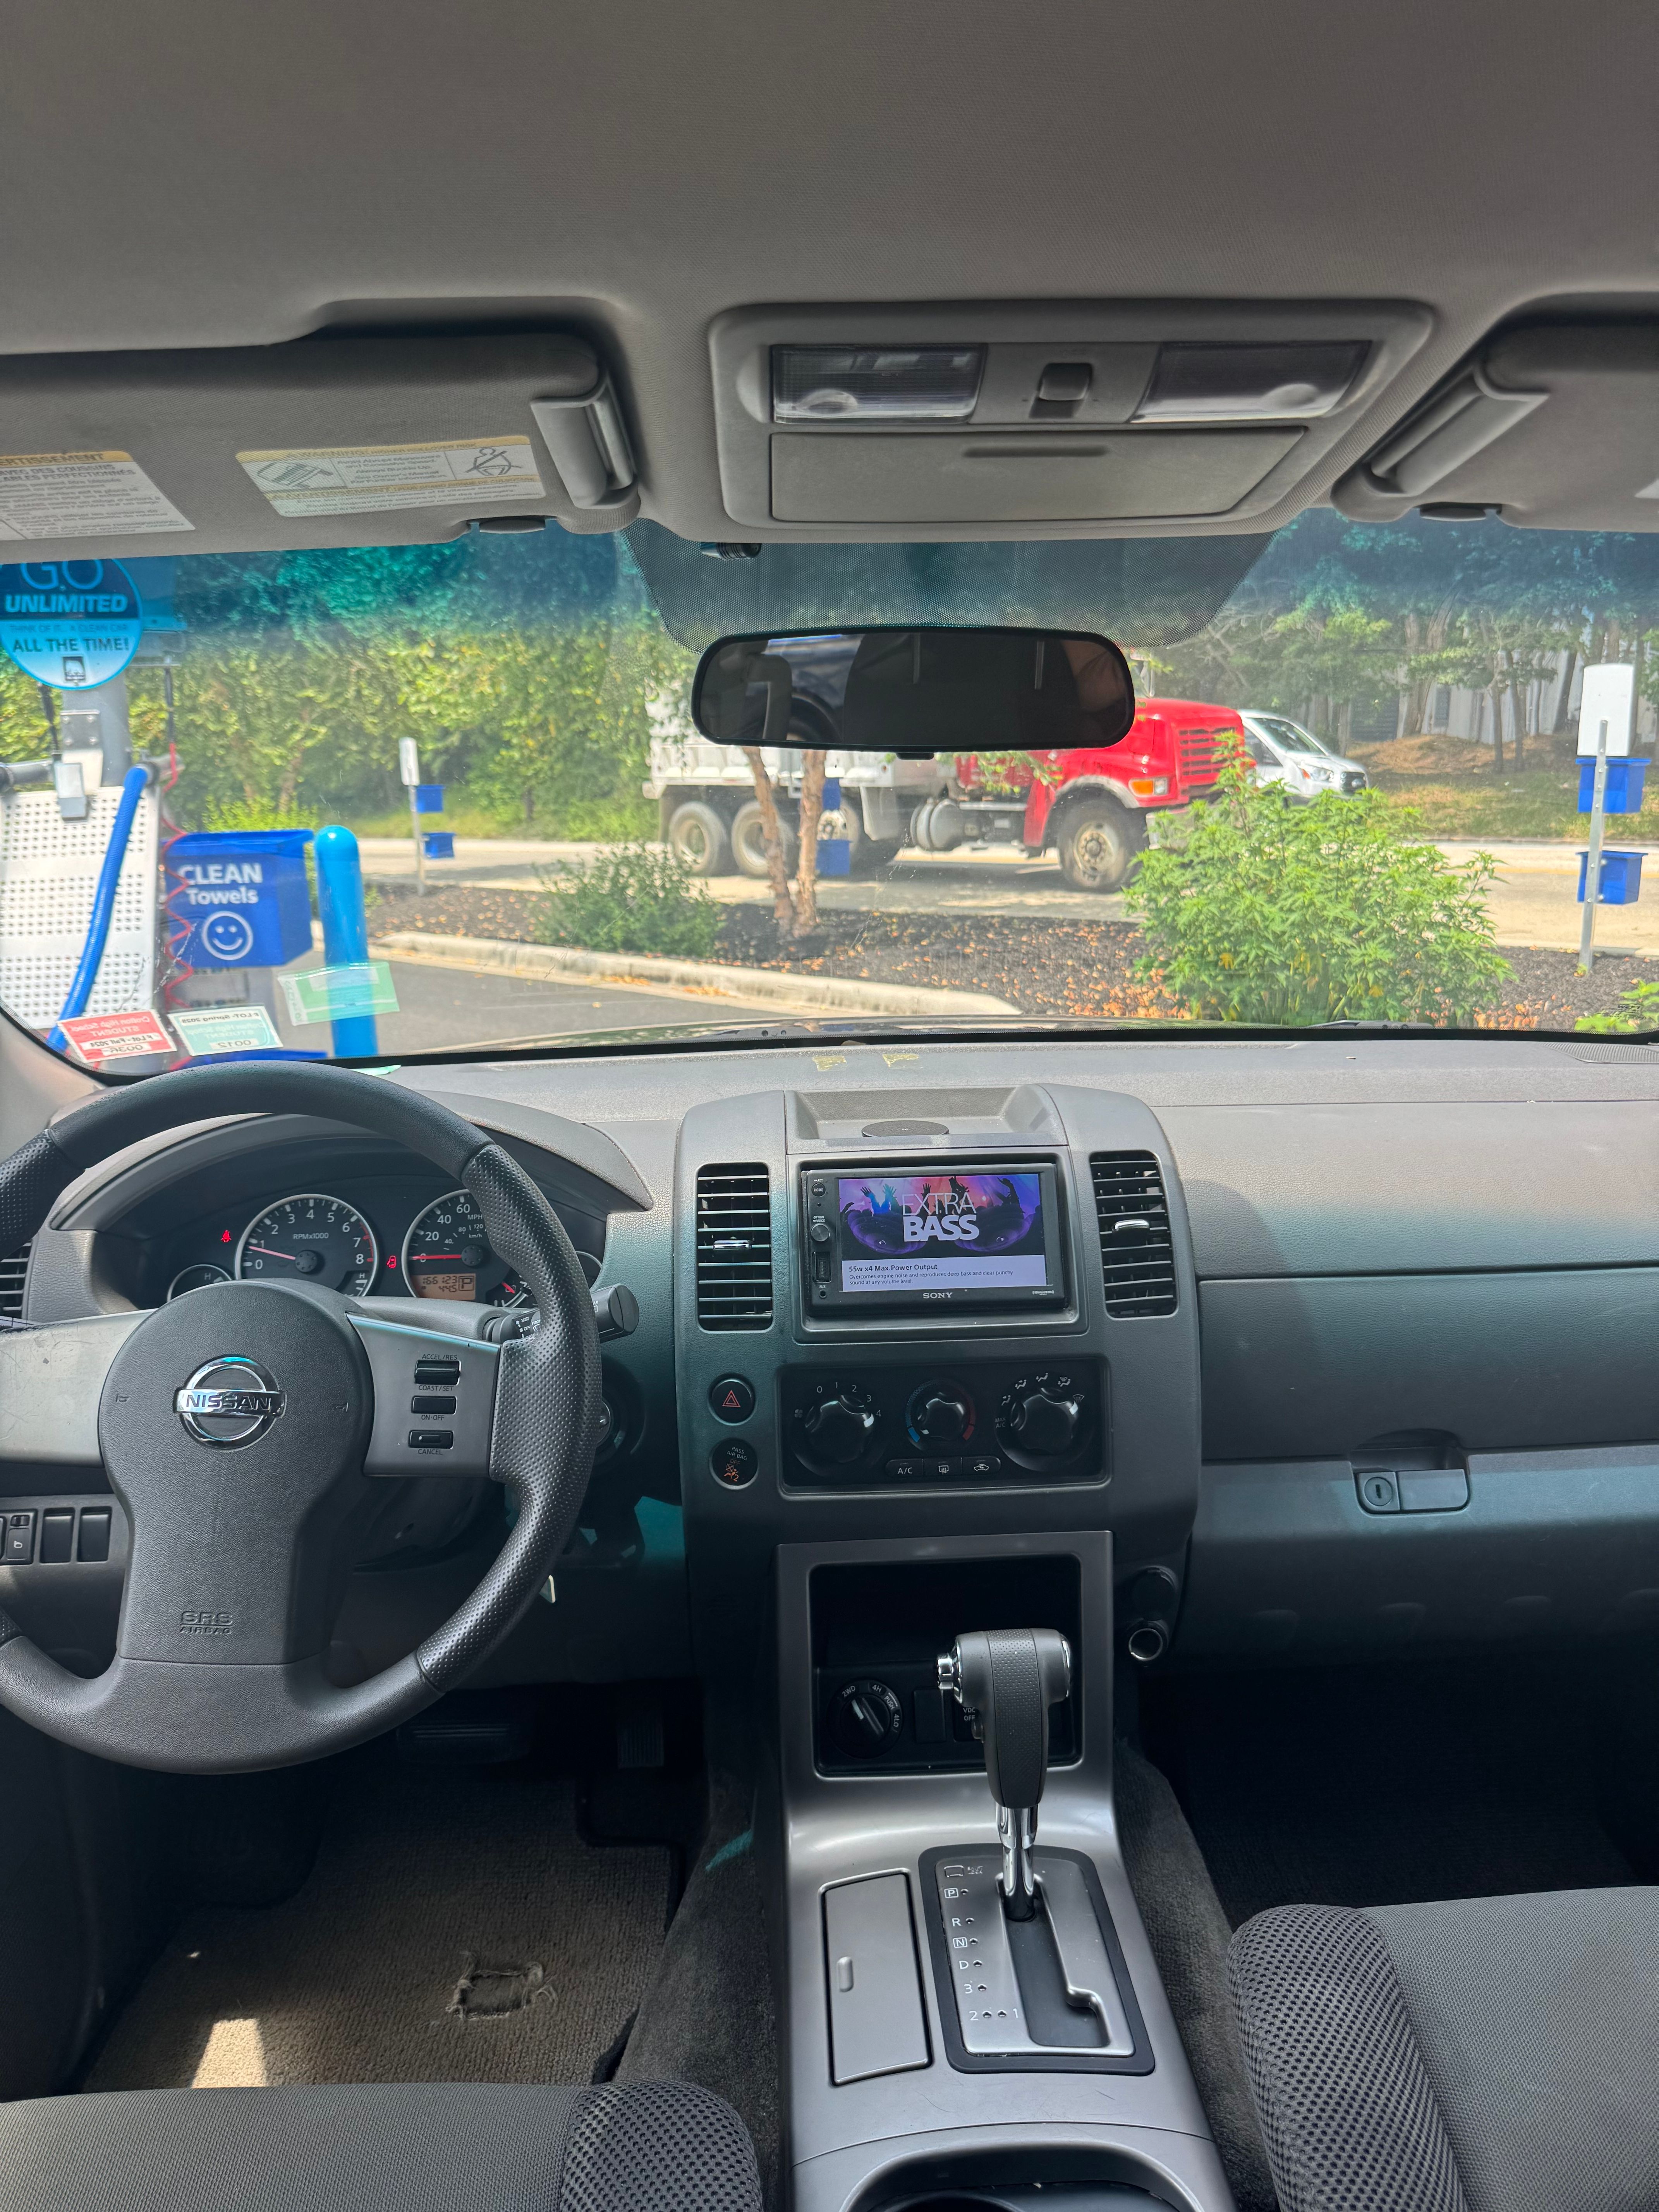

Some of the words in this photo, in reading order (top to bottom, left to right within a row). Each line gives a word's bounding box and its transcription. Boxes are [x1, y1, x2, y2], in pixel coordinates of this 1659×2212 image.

[21, 559, 103, 590] GO
[5, 593, 128, 613] UNLIMITED
[13, 639, 42, 652] ALL
[46, 638, 79, 652] THE
[84, 637, 129, 651] TIME!
[177, 862, 263, 885] CLEAN
[185, 885, 259, 905] Towels
[456, 1204, 471, 1213] 60
[902, 1192, 977, 1216] EXTRA
[288, 1214, 295, 1224] 3
[306, 1209, 314, 1219] 4
[328, 1212, 335, 1222] 5
[437, 1214, 452, 1224] 40
[271, 1224, 279, 1235] 2
[342, 1222, 350, 1233] 6
[903, 1214, 980, 1242] BASS
[425, 1231, 440, 1241] 20
[260, 1240, 264, 1249] 1
[353, 1237, 361, 1248] 7
[255, 1259, 263, 1270] 0
[356, 1254, 364, 1264] 8
[461, 1277, 472, 1289] P
[186, 1395, 271, 1410] NISSAN
[866, 1394, 872, 1402] 3
[181, 1611, 233, 1625] SRS
[842, 1685, 856, 1698] 2WD
[884, 1695, 896, 1710] PUSH
[952, 1917, 962, 1927] R
[956, 1938, 965, 1947] N
[959, 1960, 969, 1970] D
[964, 1984, 973, 1994] 3
[969, 2010, 979, 2021] 2
[1013, 2008, 1019, 2019] 1
